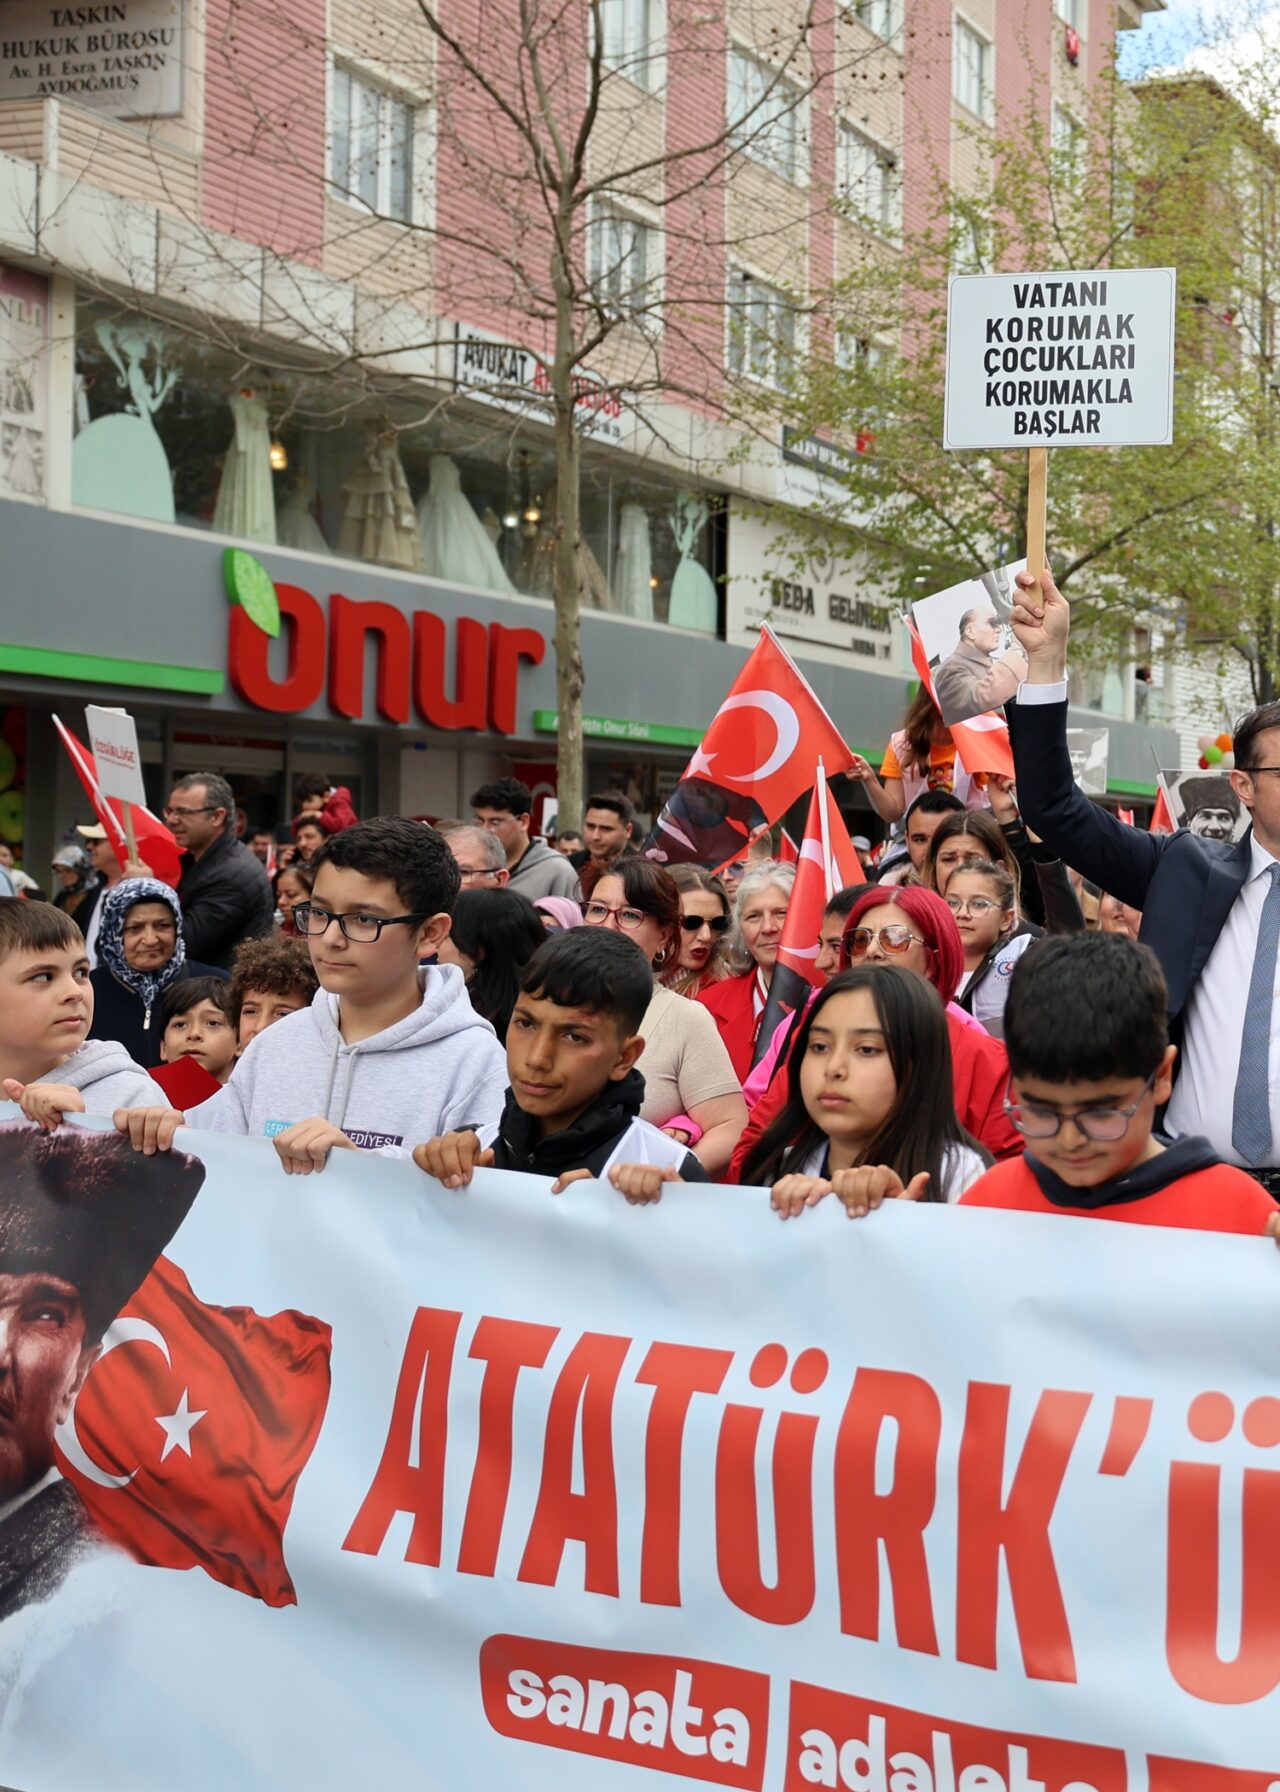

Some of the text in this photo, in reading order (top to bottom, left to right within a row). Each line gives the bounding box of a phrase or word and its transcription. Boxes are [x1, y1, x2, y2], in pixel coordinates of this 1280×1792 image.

[51, 4, 126, 29] TAŞKIN
[2, 28, 175, 59] HUKUK BÜROSU
[10, 52, 166, 79] Av. H. Esra TAŞKIN
[36, 74, 140, 94] AYDOĞMUŞ
[1013, 281, 1107, 309] VATANI
[986, 314, 1135, 343] KORUMAK
[464, 334, 527, 386] AVUKAT
[984, 344, 1135, 377] ÇOCUKLARI
[986, 378, 1133, 407] KORUMAKLA
[1014, 409, 1100, 437] BAŞLAR
[506, 1669, 750, 1767] sanata
